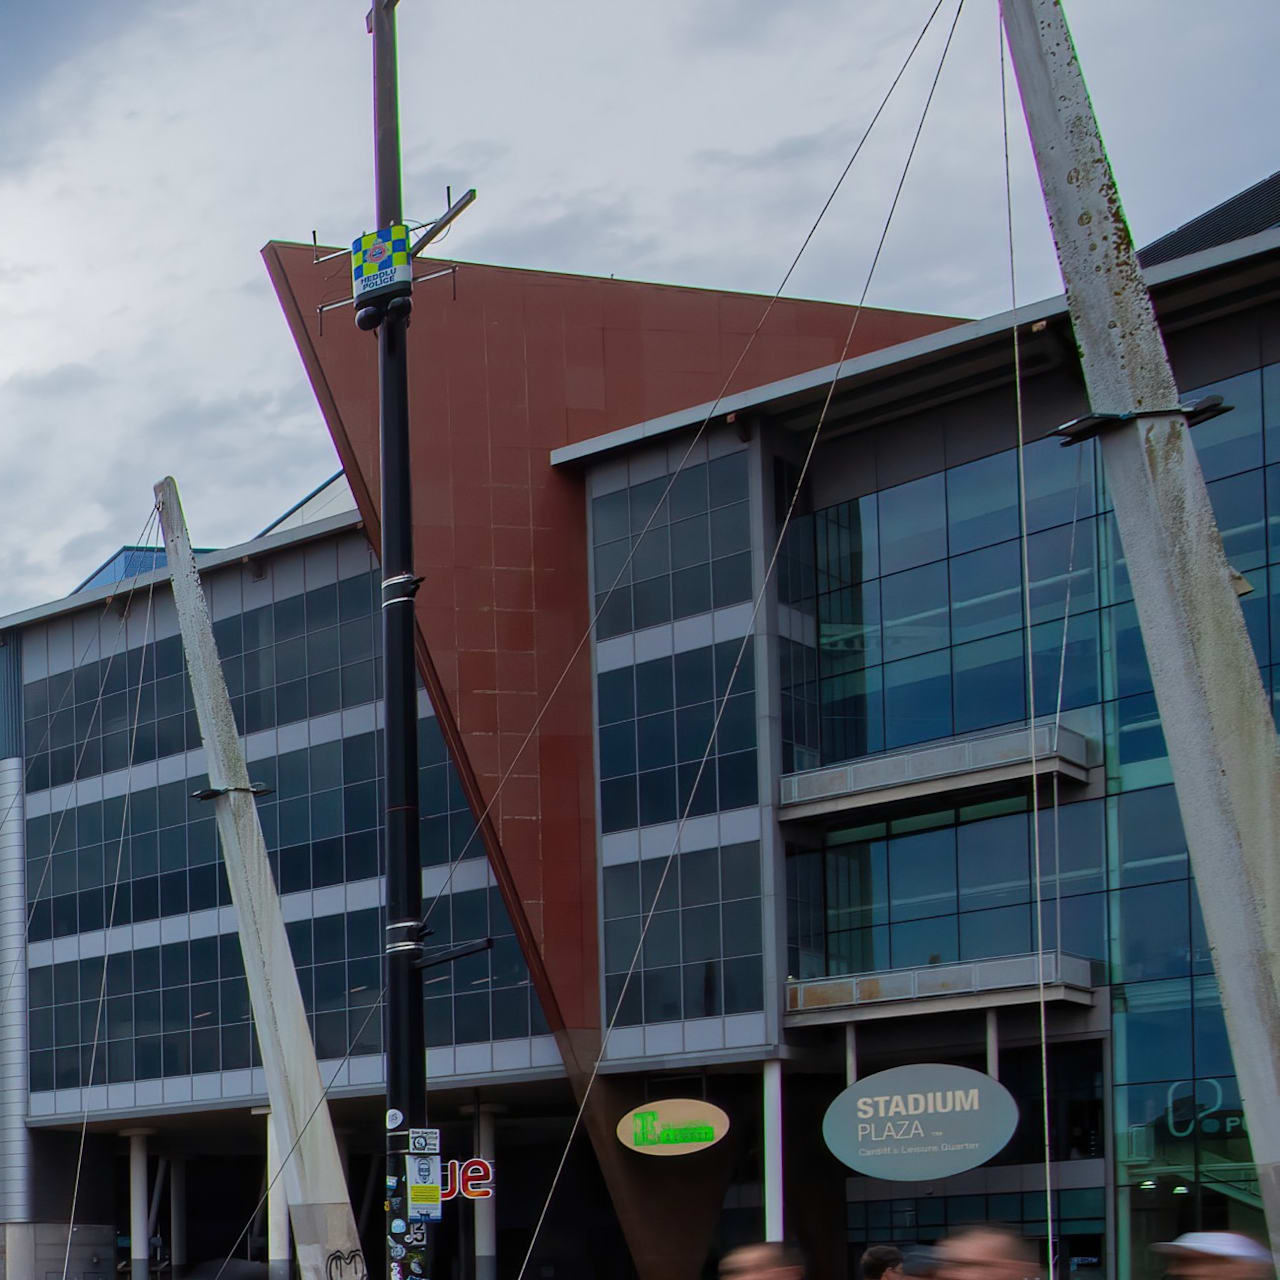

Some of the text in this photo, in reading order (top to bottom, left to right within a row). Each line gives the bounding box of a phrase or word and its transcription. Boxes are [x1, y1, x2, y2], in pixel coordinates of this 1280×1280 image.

[362, 267, 397, 284] HEDDLU
[362, 275, 395, 290] POLICE
[856, 1088, 980, 1119] STADIUM
[858, 1120, 925, 1142] PLAZA
[901, 1144, 938, 1154] Leisure
[941, 1142, 980, 1151] Quarter
[441, 1158, 493, 1201] ue
